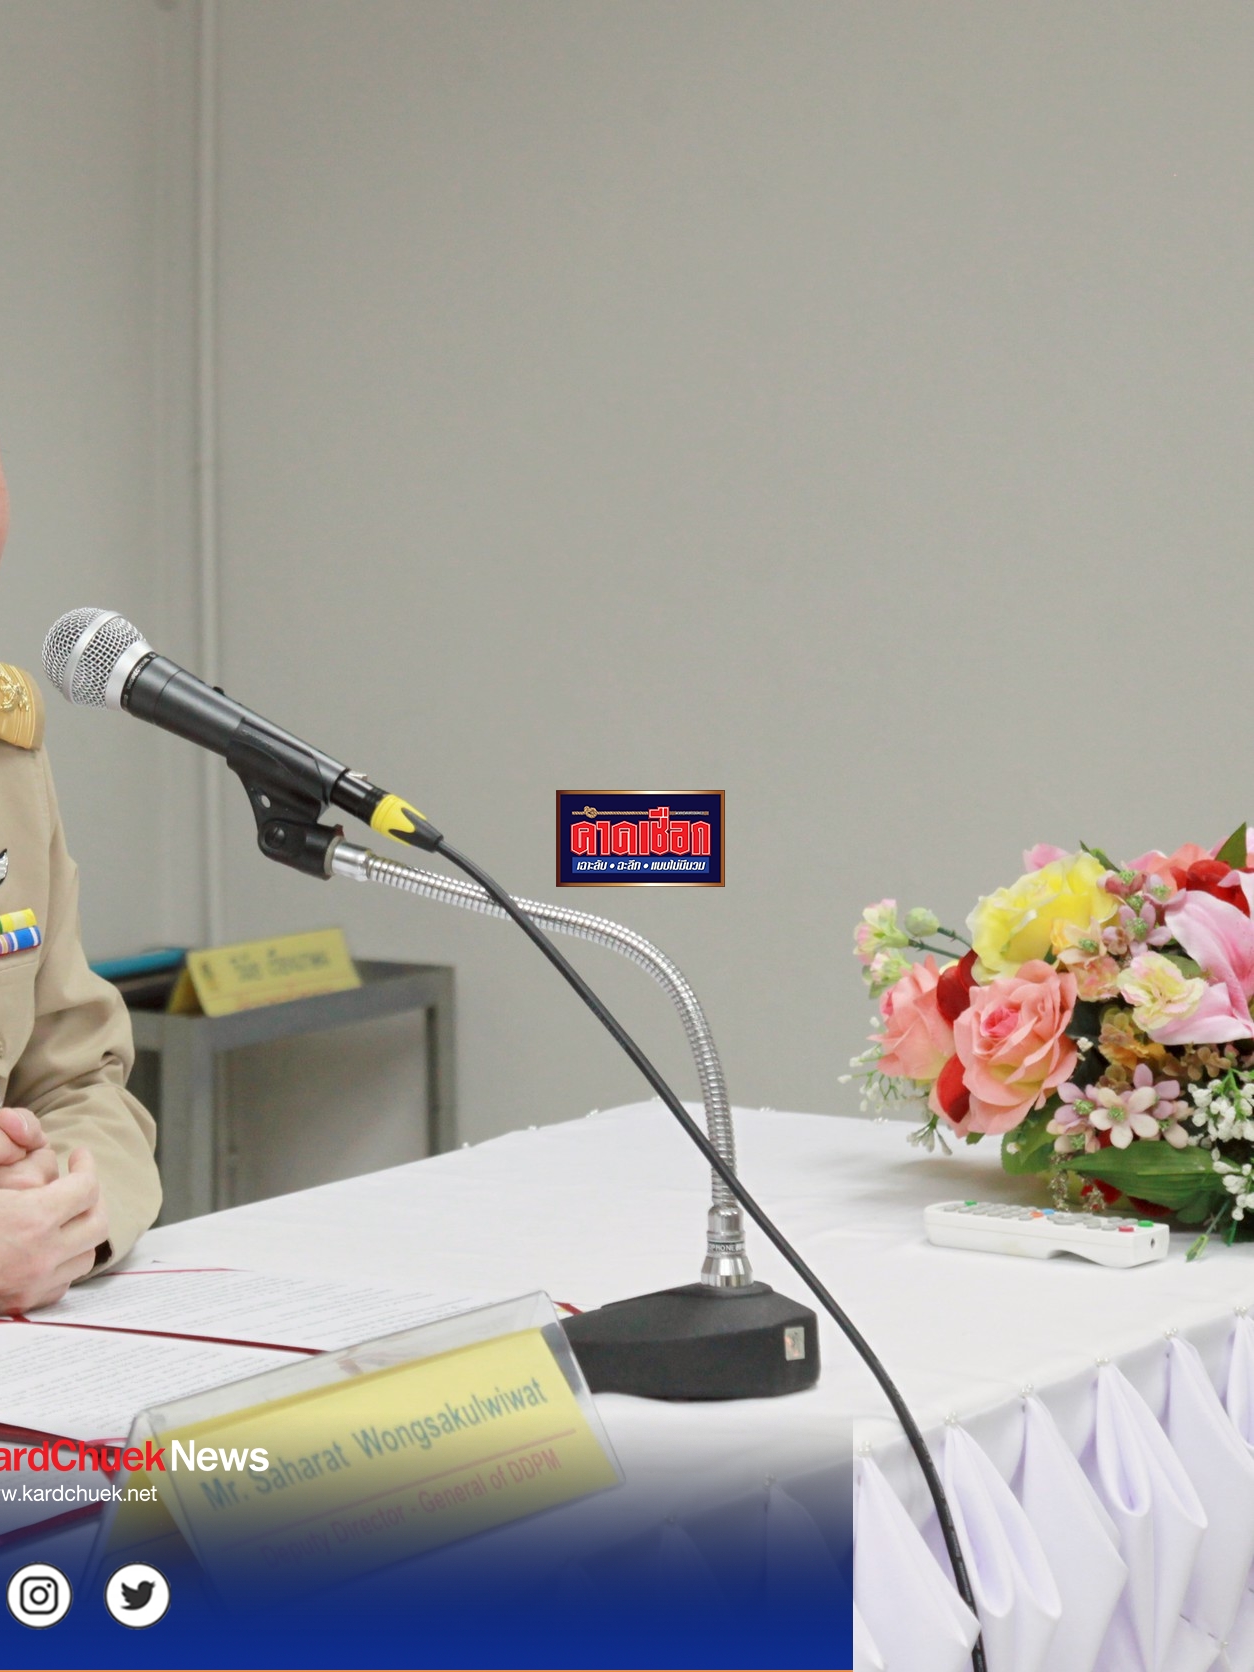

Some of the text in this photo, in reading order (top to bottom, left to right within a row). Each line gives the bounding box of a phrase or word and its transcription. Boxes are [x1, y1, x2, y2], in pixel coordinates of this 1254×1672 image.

[200, 1477, 249, 1511] Mr.
[248, 1440, 351, 1494] Saharat
[351, 1377, 548, 1460] Wongsakulwiwat
[259, 1531, 332, 1570] Deputy
[330, 1505, 406, 1544] Director
[417, 1473, 488, 1514] General
[489, 1465, 508, 1490] of
[506, 1448, 562, 1484] DDPM
